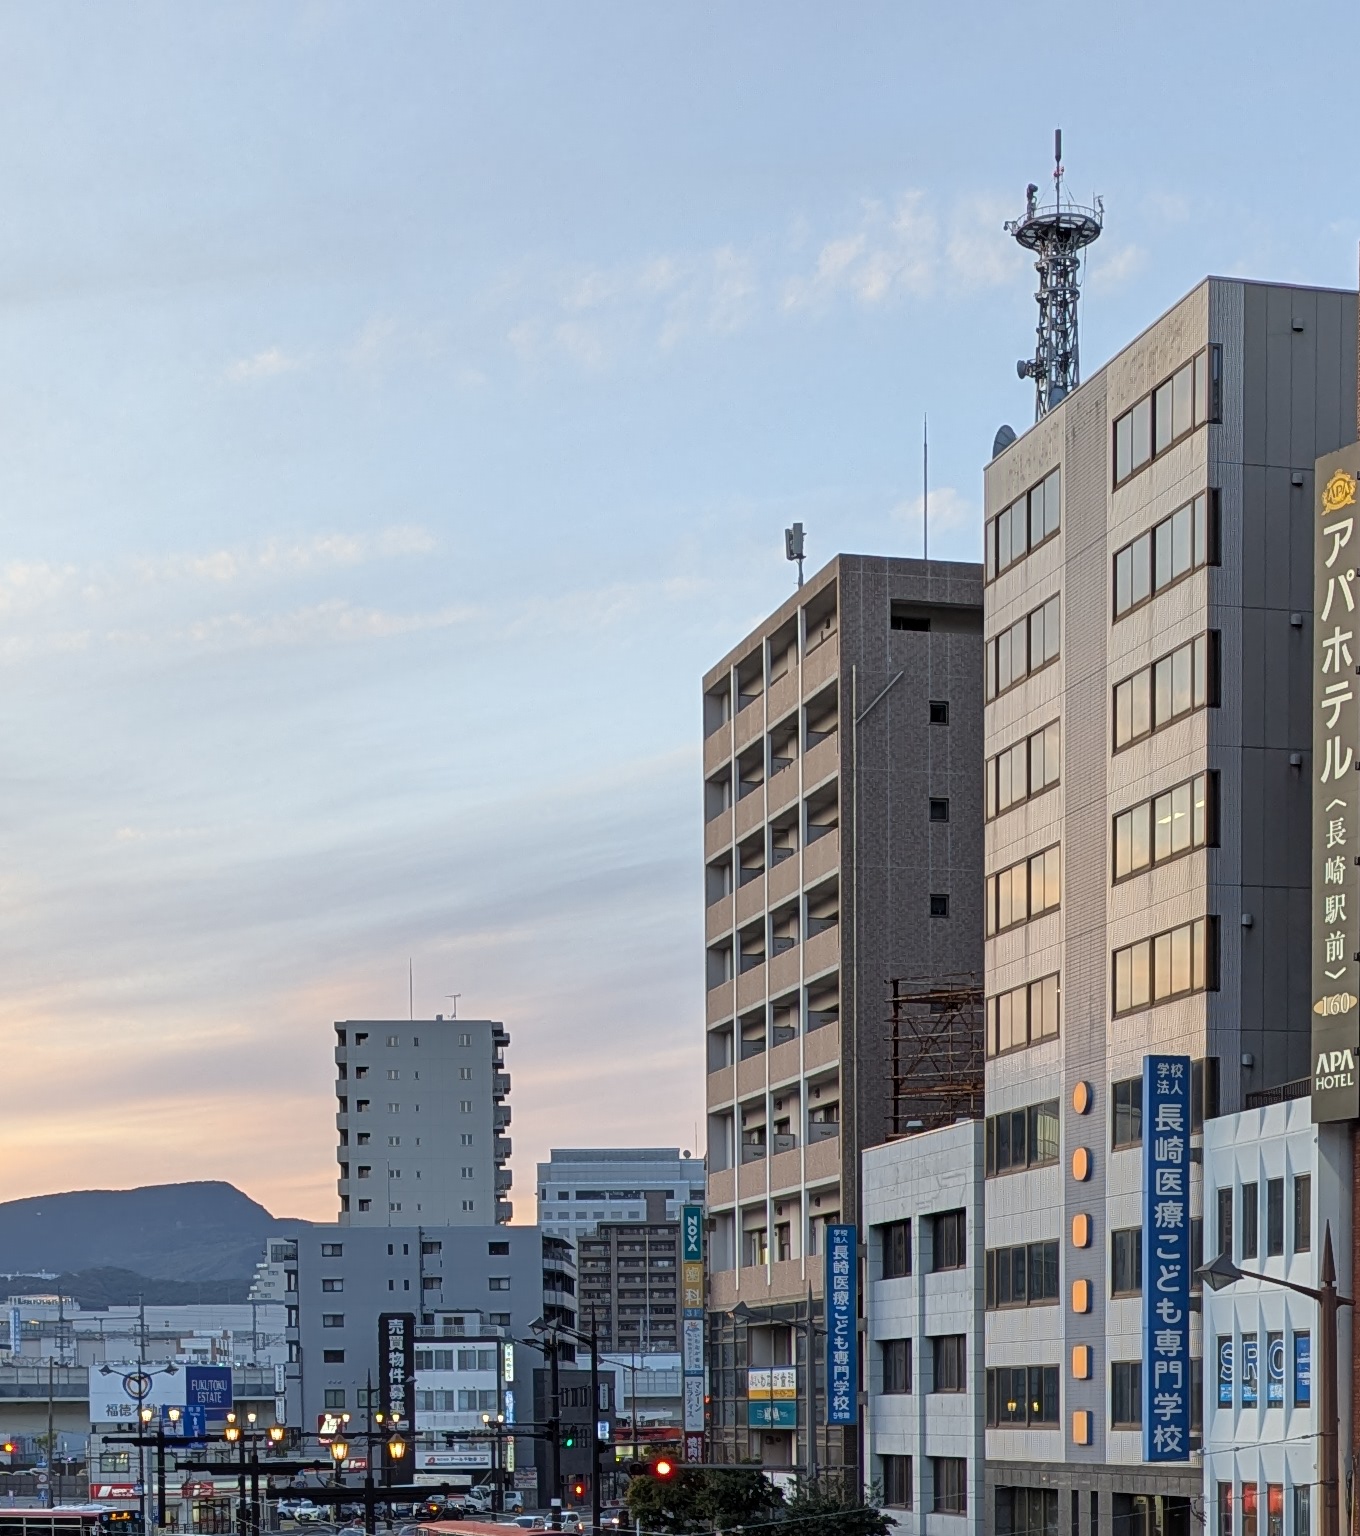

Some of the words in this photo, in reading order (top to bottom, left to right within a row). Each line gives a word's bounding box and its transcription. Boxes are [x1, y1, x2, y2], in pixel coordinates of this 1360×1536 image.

[1320, 517, 1355, 784] アパホテル
[1321, 992, 1351, 1017] 160
[1156, 1062, 1184, 1078] 学校
[1316, 1048, 1354, 1074] APA
[1156, 1079, 1184, 1096] 法人
[1315, 1072, 1354, 1091] HOTEL
[687, 1215, 698, 1252] NOVA
[1153, 1103, 1184, 1453] 長崎医療こども専門学校
[832, 1245, 850, 1411] 長崎医療こども専門学校
[105, 1403, 165, 1417] 福徳不動
[197, 1391, 222, 1404] ESTATE
